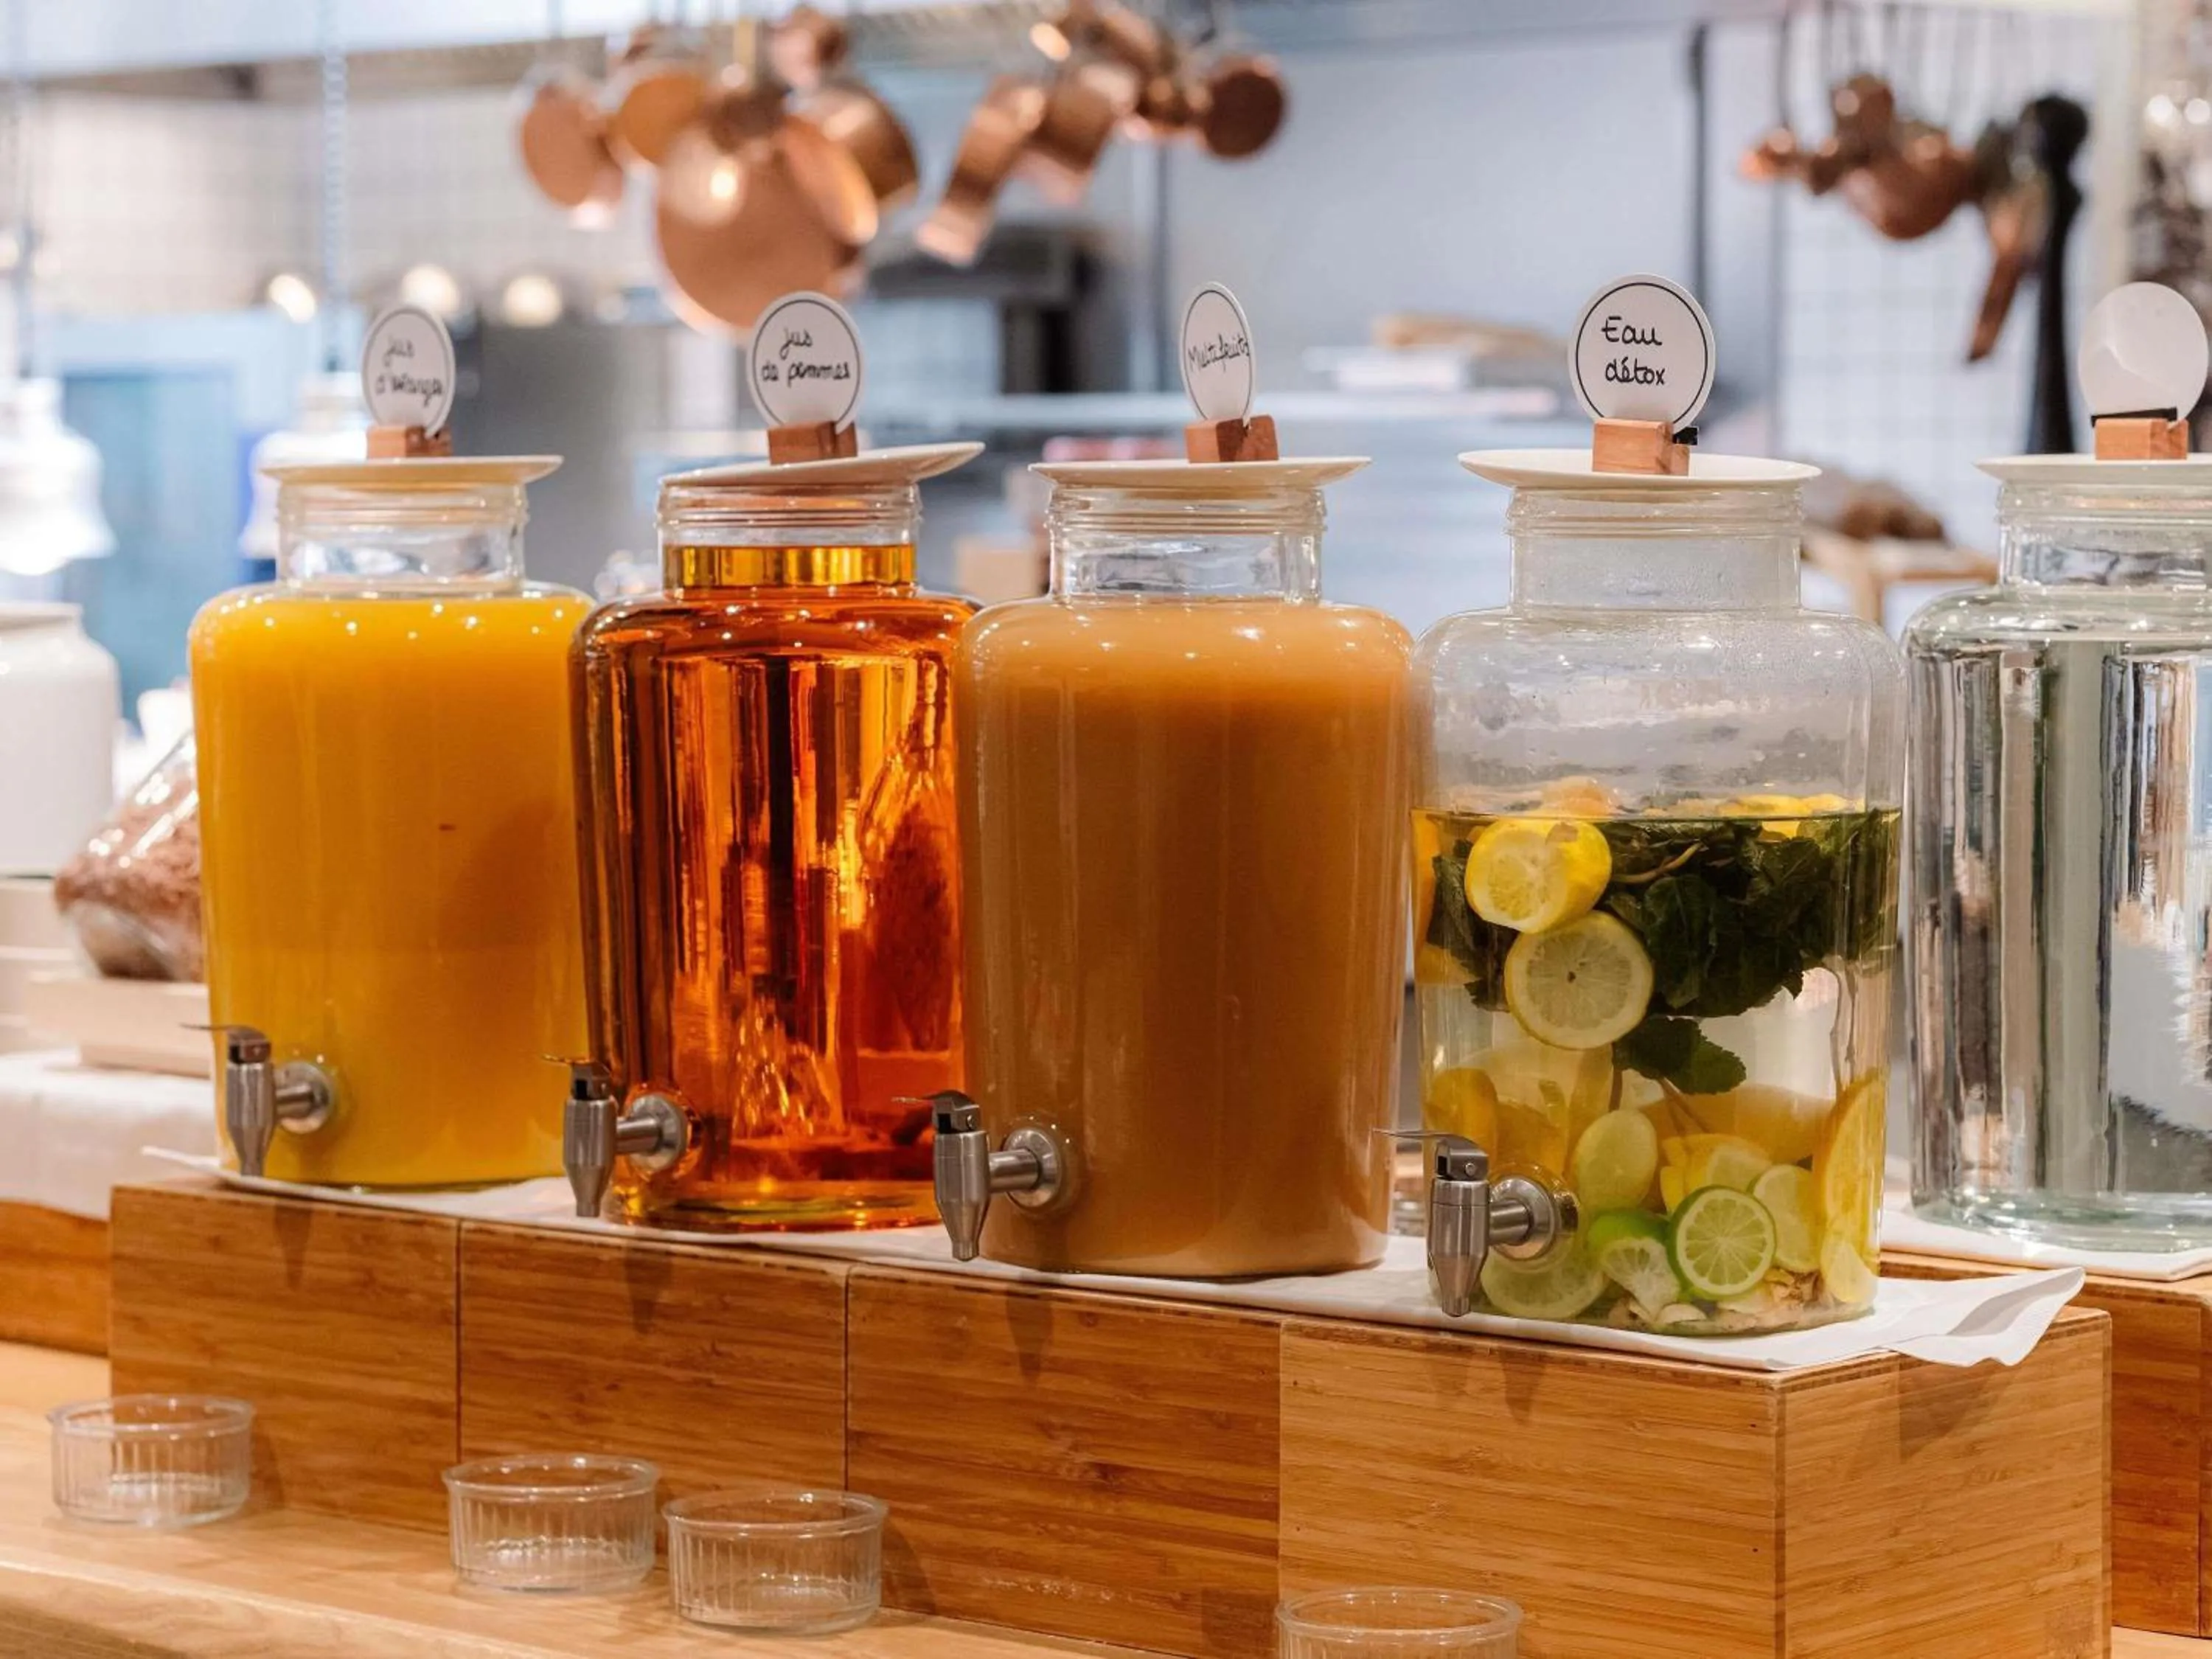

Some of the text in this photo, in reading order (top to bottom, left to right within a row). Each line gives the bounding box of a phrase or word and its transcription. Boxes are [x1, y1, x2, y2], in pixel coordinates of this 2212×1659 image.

[1601, 315, 1663, 347] Eau
[762, 361, 851, 389] de pommes
[1604, 355, 1666, 386] détox
